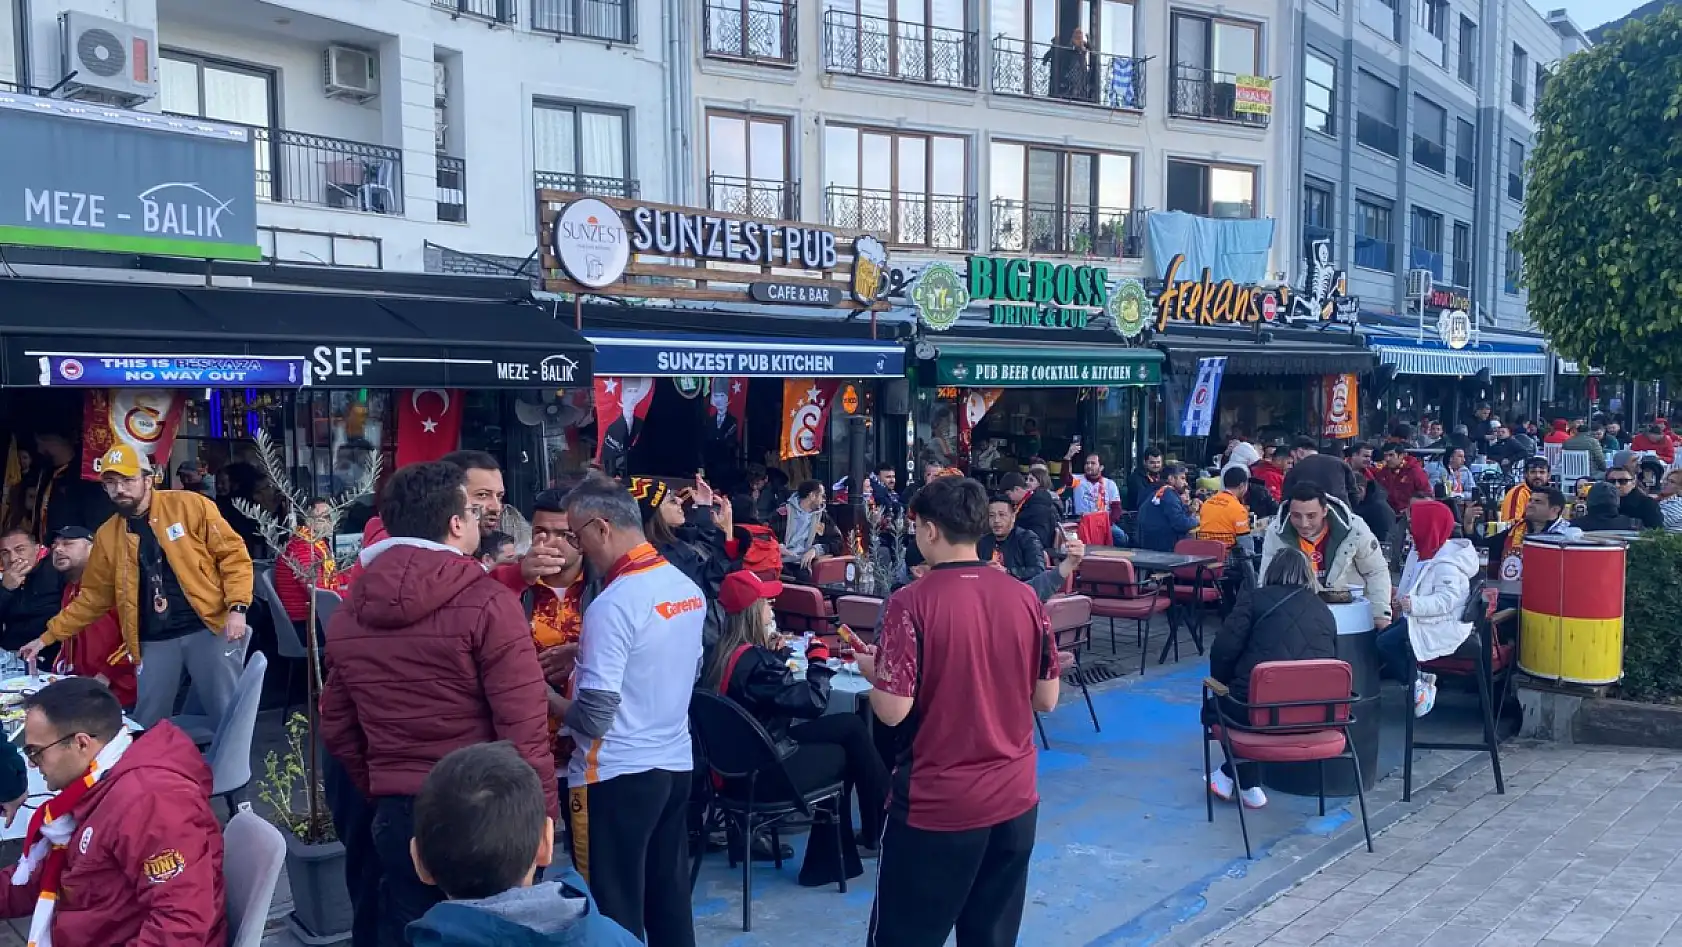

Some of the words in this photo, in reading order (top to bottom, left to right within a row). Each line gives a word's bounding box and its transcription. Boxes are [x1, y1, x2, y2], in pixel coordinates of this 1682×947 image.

[24, 188, 106, 228] MEZE
[142, 198, 223, 238] BALIK
[563, 221, 624, 244] SUNZEST
[631, 206, 777, 263] SUNZEST
[783, 227, 838, 269] PUB
[966, 256, 1030, 302] BIG
[1029, 261, 1109, 308] BOSS
[767, 284, 796, 301] CAFE
[798, 286, 807, 302] &
[809, 286, 830, 303] BAR
[990, 304, 1040, 326] DRINK
[1043, 308, 1055, 326] &
[1060, 309, 1087, 328] PUB
[100, 358, 150, 368] THIS
[152, 358, 170, 368] IS
[313, 346, 372, 381] ŞEF
[497, 362, 529, 380] MEZE
[541, 363, 574, 382] BALIK
[658, 352, 734, 371] SUNZEST
[738, 353, 769, 371] PUB
[771, 354, 835, 372] KITCHEN
[975, 364, 998, 380] PUB
[1001, 365, 1028, 380] BEER
[1031, 365, 1079, 380] COCKTAIL
[1081, 367, 1089, 379] &
[1091, 366, 1131, 380] KITCHEN
[125, 371, 155, 381] NO
[160, 371, 203, 381] WAY
[208, 371, 247, 381] OUT
